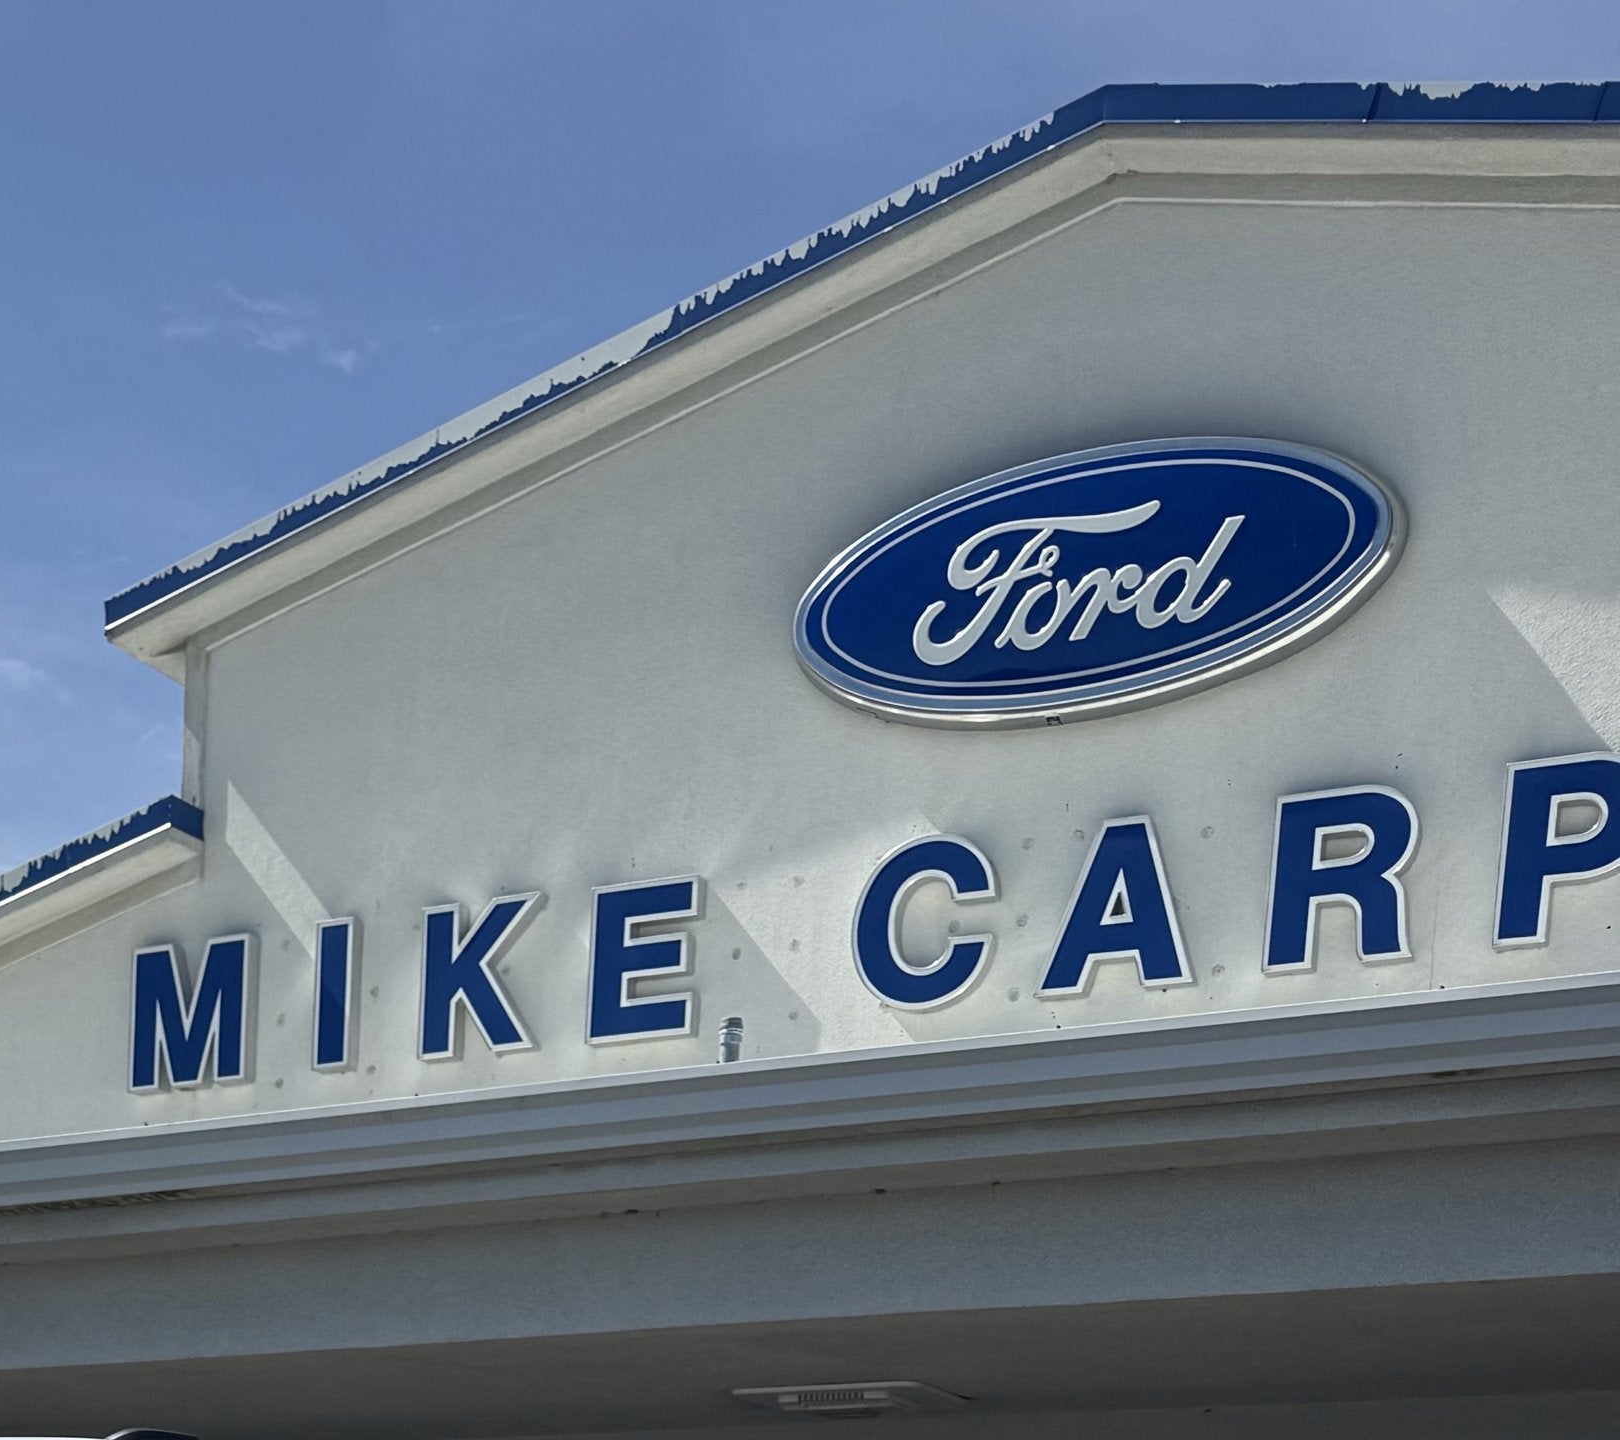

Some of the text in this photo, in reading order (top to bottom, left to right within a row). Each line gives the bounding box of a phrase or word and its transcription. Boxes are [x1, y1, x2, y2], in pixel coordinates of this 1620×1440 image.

[912, 498, 1246, 667] Ford
[127, 751, 1620, 1094] MIKE CARP
